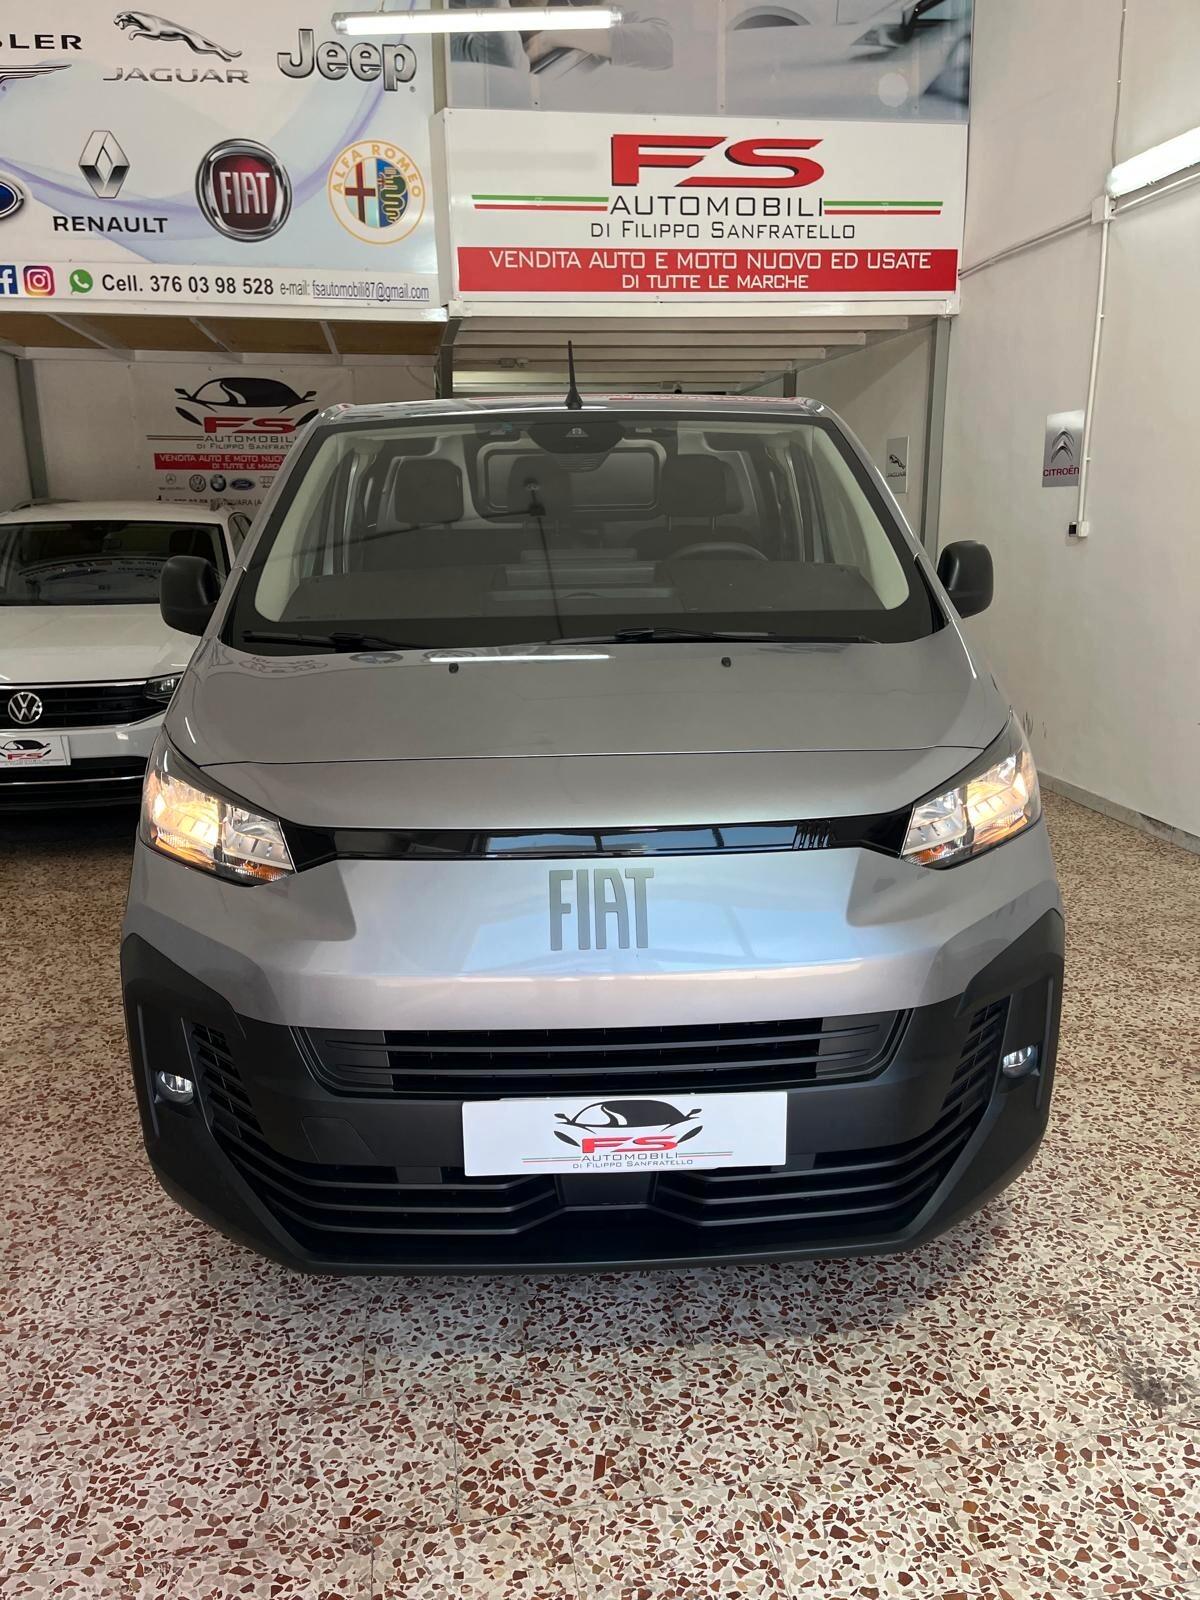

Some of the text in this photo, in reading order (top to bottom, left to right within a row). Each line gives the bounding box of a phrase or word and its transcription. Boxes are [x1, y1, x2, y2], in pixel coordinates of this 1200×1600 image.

[0, 34, 82, 50] LER
[277, 28, 417, 91] Jeep
[103, 67, 250, 84] JAGUAR
[332, 144, 421, 197] ALFA ROMEO
[610, 133, 825, 189] FS
[218, 170, 271, 215] FIAT
[609, 195, 824, 218] AUTOMOBILI
[53, 216, 168, 234] RENAULT
[590, 221, 855, 240] DI FILIPPO SANFRATELLO
[489, 250, 931, 270] VENDITA AUTO E MOTO NUOVO ED USATE
[102, 274, 143, 292] Cell.
[150, 275, 182, 293] 376
[188, 276, 210, 294] 03
[215, 277, 237, 294] 98
[243, 278, 274, 295] 528
[280, 280, 310, 296] e-mail:
[621, 275, 809, 290] DI TUTTE LE MARCHE
[204, 417, 297, 434] FS
[159, 454, 197, 463] VENDITA
[198, 454, 221, 463] AUTO
[233, 454, 260, 463] MOTO
[548, 867, 655, 951] FIAT
[582, 1135, 678, 1154] FS
[581, 1152, 678, 1162] AUTOMOBILI
[586, 1161, 622, 1169] FILIPPO
[626, 1159, 693, 1168] SANFRATELLO
